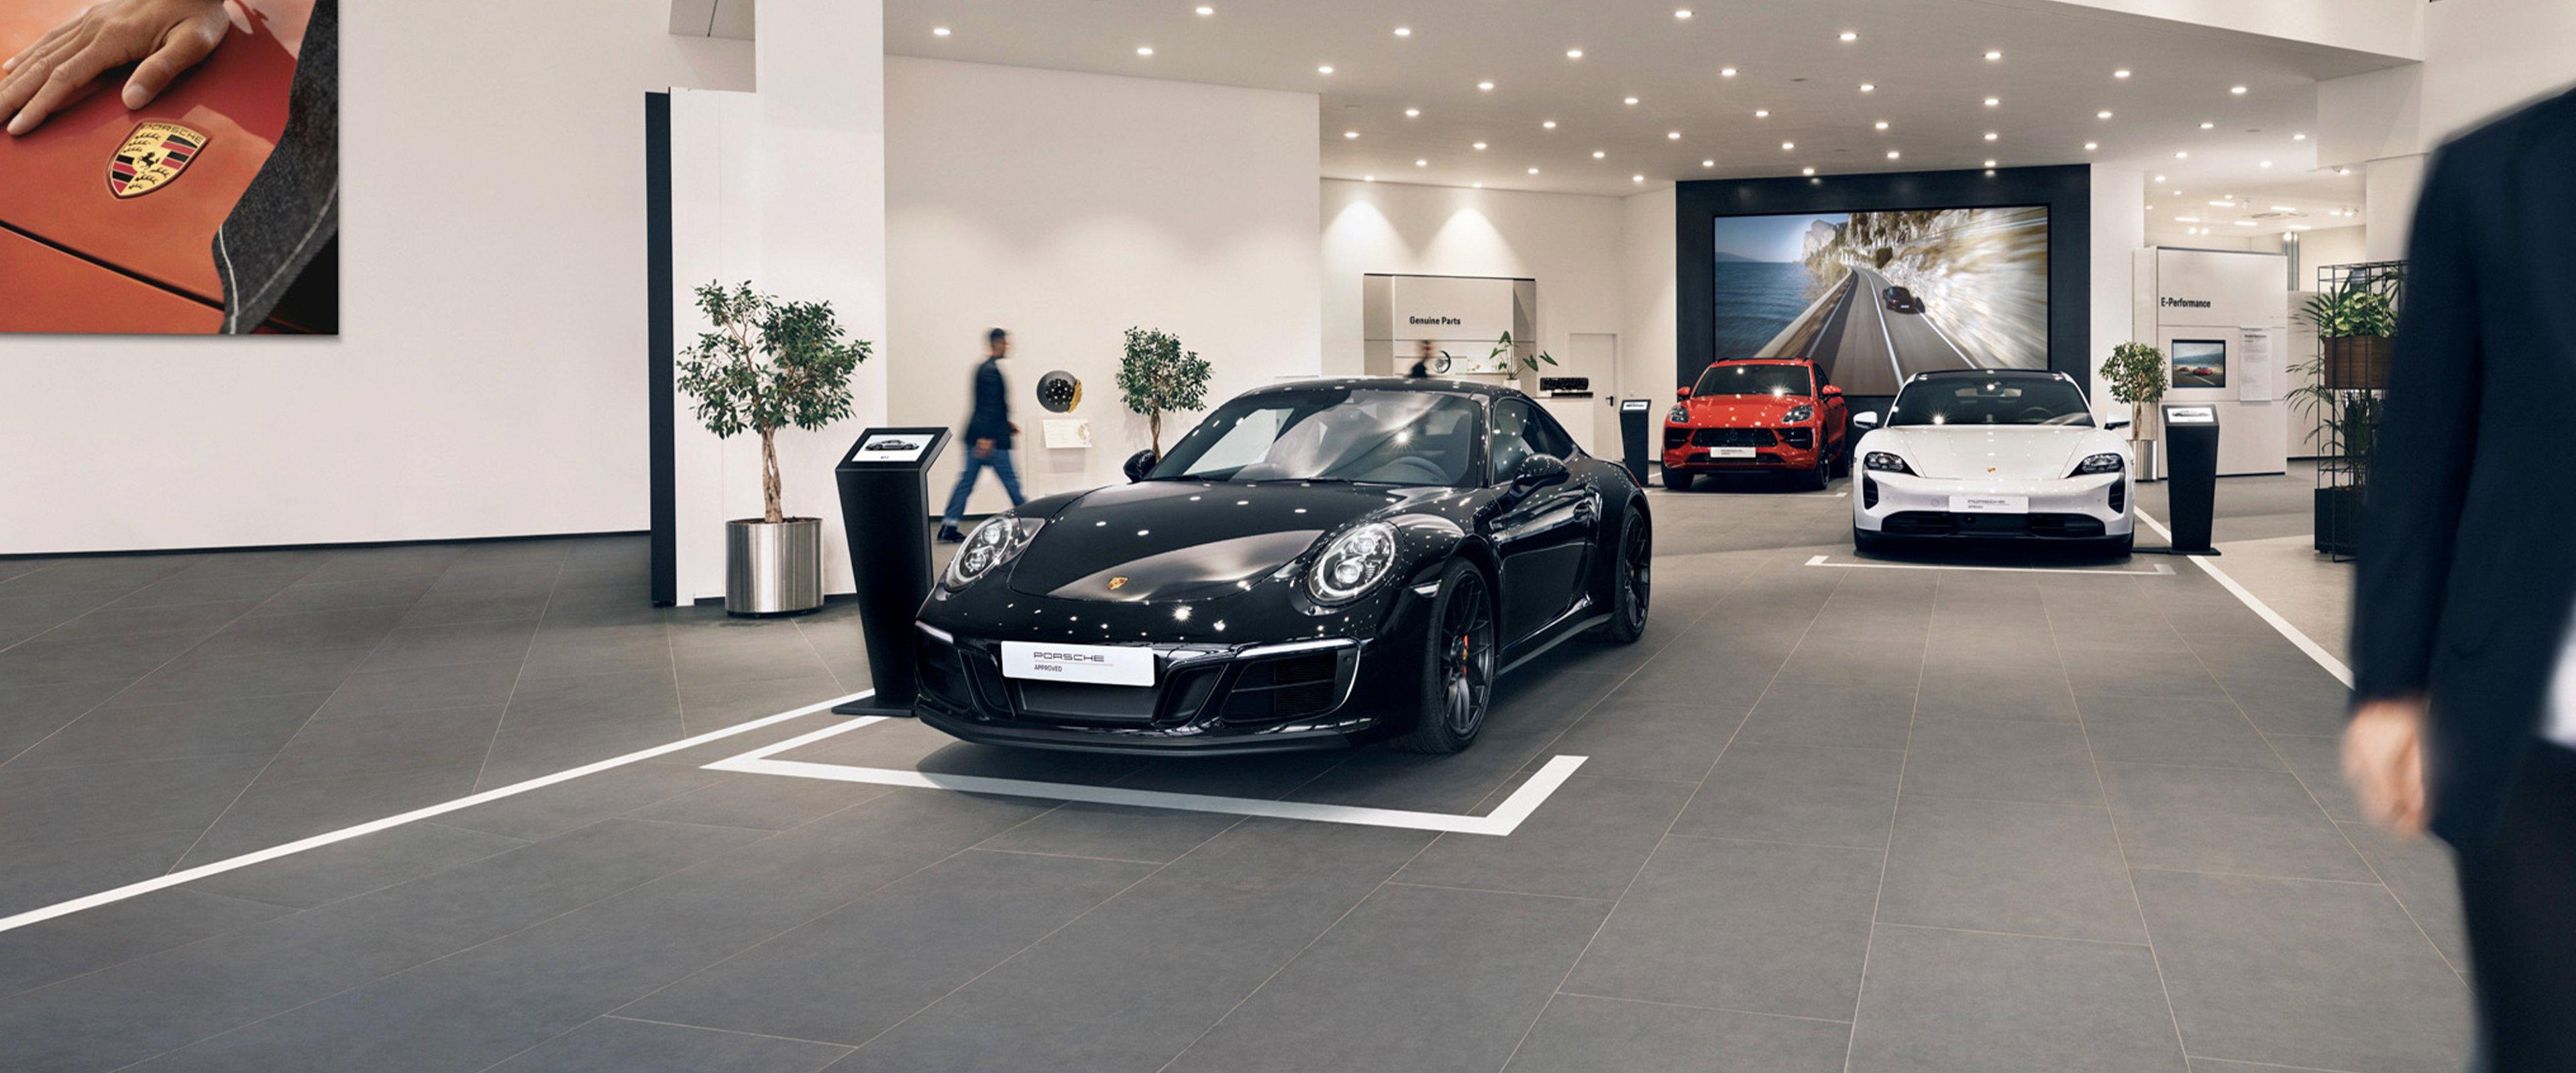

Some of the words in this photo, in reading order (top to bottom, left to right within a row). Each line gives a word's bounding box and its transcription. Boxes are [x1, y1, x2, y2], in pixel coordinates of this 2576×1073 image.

[141, 124, 203, 144] PORSCHE
[2161, 297, 2211, 308] E-Performance
[1409, 316, 1440, 325] Genuine
[1442, 317, 1460, 325] Parts
[1034, 652, 1104, 662] PORSCHE
[1034, 664, 1063, 672] APPROVED
